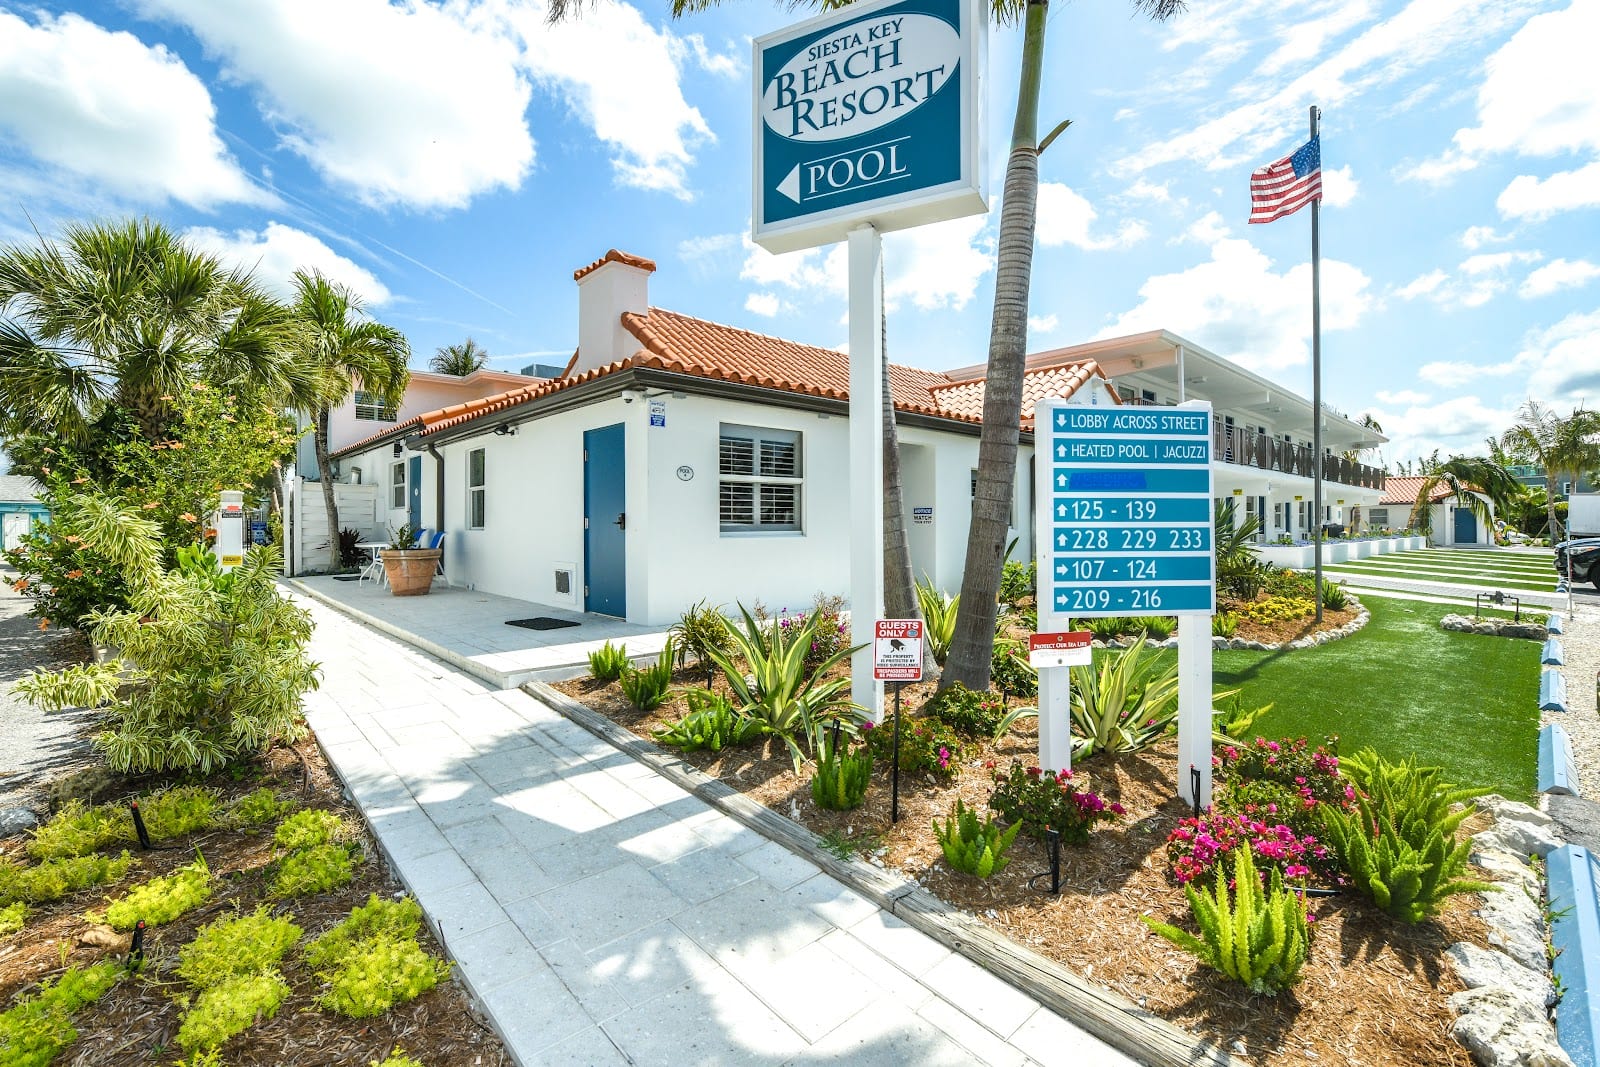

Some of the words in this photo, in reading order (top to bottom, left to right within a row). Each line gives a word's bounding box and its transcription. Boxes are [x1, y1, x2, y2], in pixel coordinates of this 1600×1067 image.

[808, 33, 863, 62] SIESTA
[868, 17, 904, 43] KEY
[772, 38, 903, 111] BEACH
[788, 64, 945, 138] RESORT
[807, 145, 907, 194] POOL
[1071, 414, 1109, 428] LOBBY
[1112, 415, 1158, 430] ACROSS
[1161, 416, 1205, 431] STREET
[1071, 444, 1115, 457] HEATED
[1118, 445, 1149, 458] POOL
[1162, 445, 1206, 459] JACUZZI
[1071, 500, 1104, 520] 125
[1125, 500, 1157, 520] 139
[1072, 530, 1109, 549] 228
[1121, 530, 1157, 549] 229
[1169, 530, 1203, 549] 233
[1072, 560, 1105, 579] 107
[1127, 560, 1157, 579] 124
[1072, 590, 1111, 609] 209
[1131, 589, 1162, 608] 216
[879, 621, 919, 629] GUESTS
[879, 629, 905, 637] ONLY
